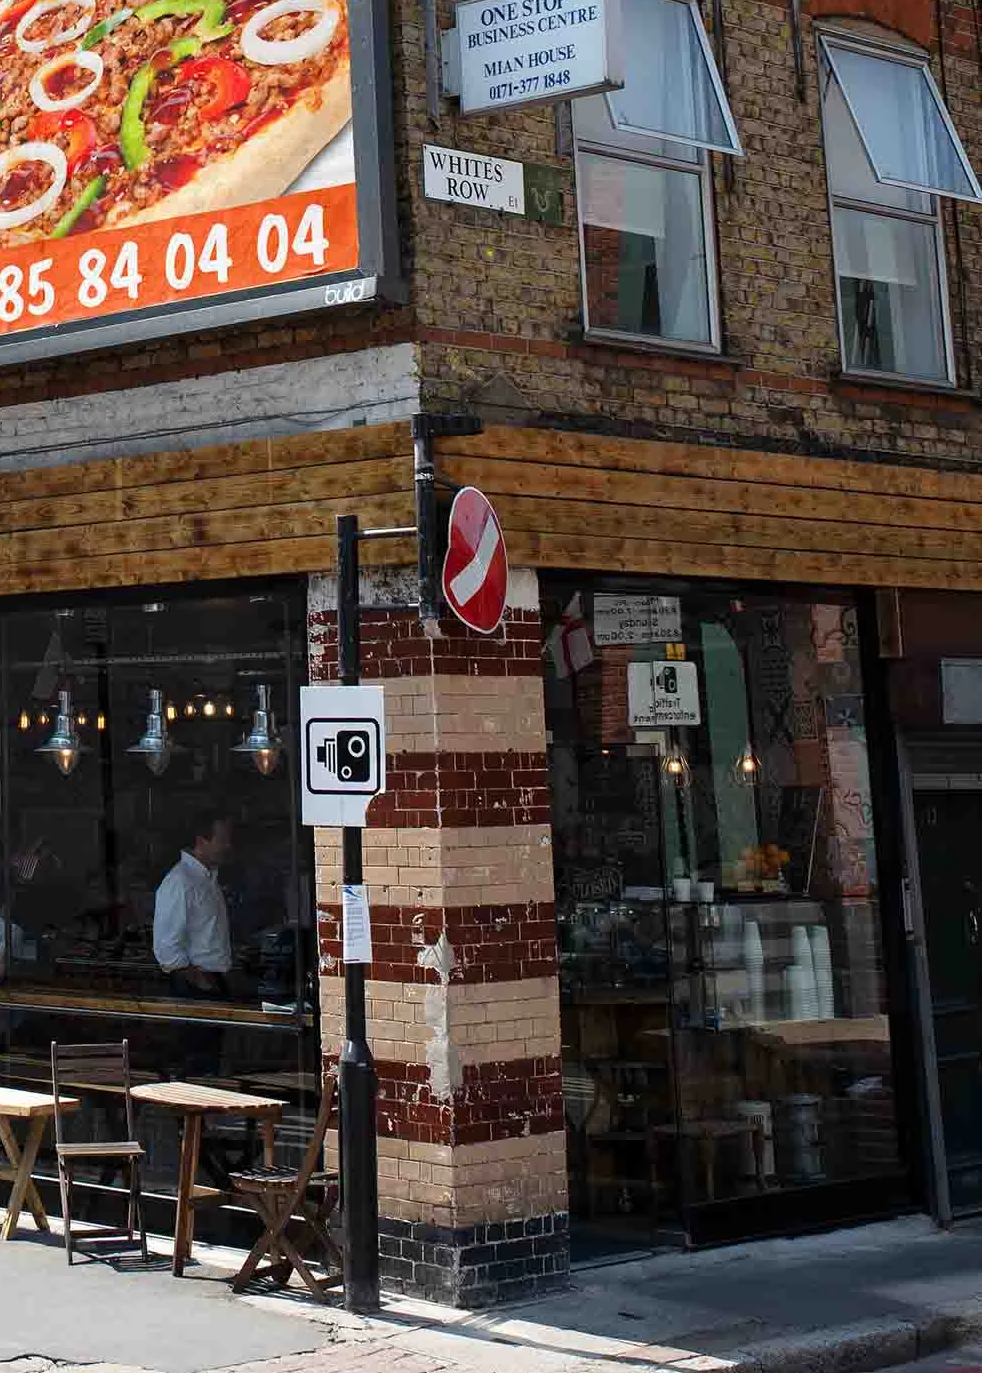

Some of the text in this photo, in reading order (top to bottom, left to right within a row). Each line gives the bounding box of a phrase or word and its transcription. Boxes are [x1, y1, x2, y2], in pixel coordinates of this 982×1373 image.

[468, 5, 598, 49] BUSINESS CENTRE
[480, 2, 518, 26] ONE
[484, 44, 576, 78] MIAN HOUSE
[489, 69, 571, 101] 0171-377 1848
[429, 152, 503, 183] WHITES
[446, 177, 490, 201] ROW
[78, 241, 142, 308] 84
[165, 223, 232, 290] 04
[257, 204, 329, 273] 04
[325, 282, 364, 305] build
